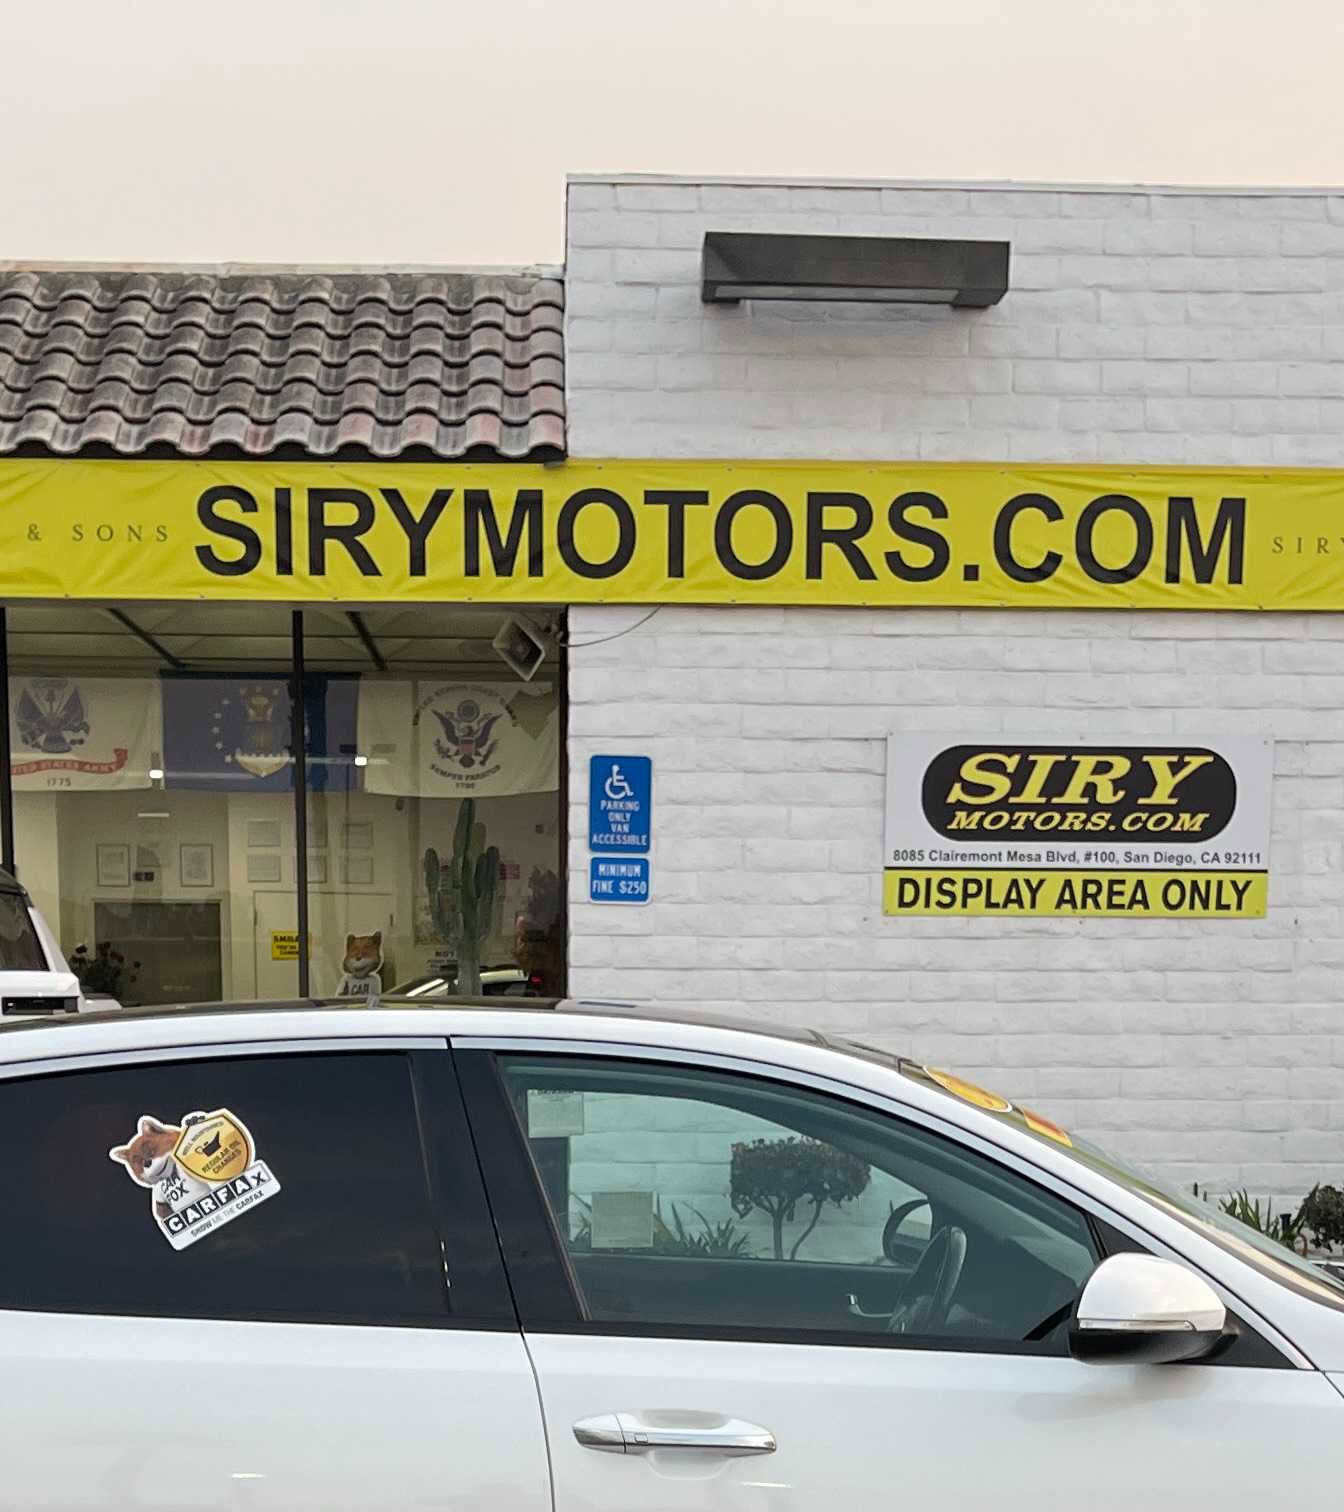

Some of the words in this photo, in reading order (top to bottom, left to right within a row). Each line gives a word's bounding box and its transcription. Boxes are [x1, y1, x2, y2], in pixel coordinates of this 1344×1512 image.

[26, 523, 42, 541] &
[71, 523, 169, 543] SONS
[195, 485, 1247, 585] SIRYMOTORS.COM
[946, 752, 1215, 807] SIRY
[599, 800, 640, 812] PARKING
[607, 812, 632, 823] ONLY
[946, 811, 1210, 833] MOTORS.COM
[610, 823, 630, 834] VAN
[591, 834, 647, 846] ACCESSIBLE
[893, 849, 925, 863] 8085
[928, 849, 1002, 864] Clairemont
[1007, 850, 1042, 864] Mesa
[1046, 850, 1080, 866] Blvd,
[1083, 850, 1120, 866] #100,
[1123, 851, 1150, 865] San
[1153, 851, 1197, 869] Diego,
[1200, 853, 1222, 866] CA
[1224, 853, 1261, 866] 92111
[598, 863, 642, 877] MINIMUM
[592, 880, 614, 894] FINE
[618, 881, 647, 895] $250
[898, 877, 1047, 911] DISPLAY
[1056, 878, 1150, 911] AREA
[1162, 879, 1253, 912] ONLY
[165, 1181, 190, 1204] FOX
[165, 1171, 267, 1234] CARFAX
